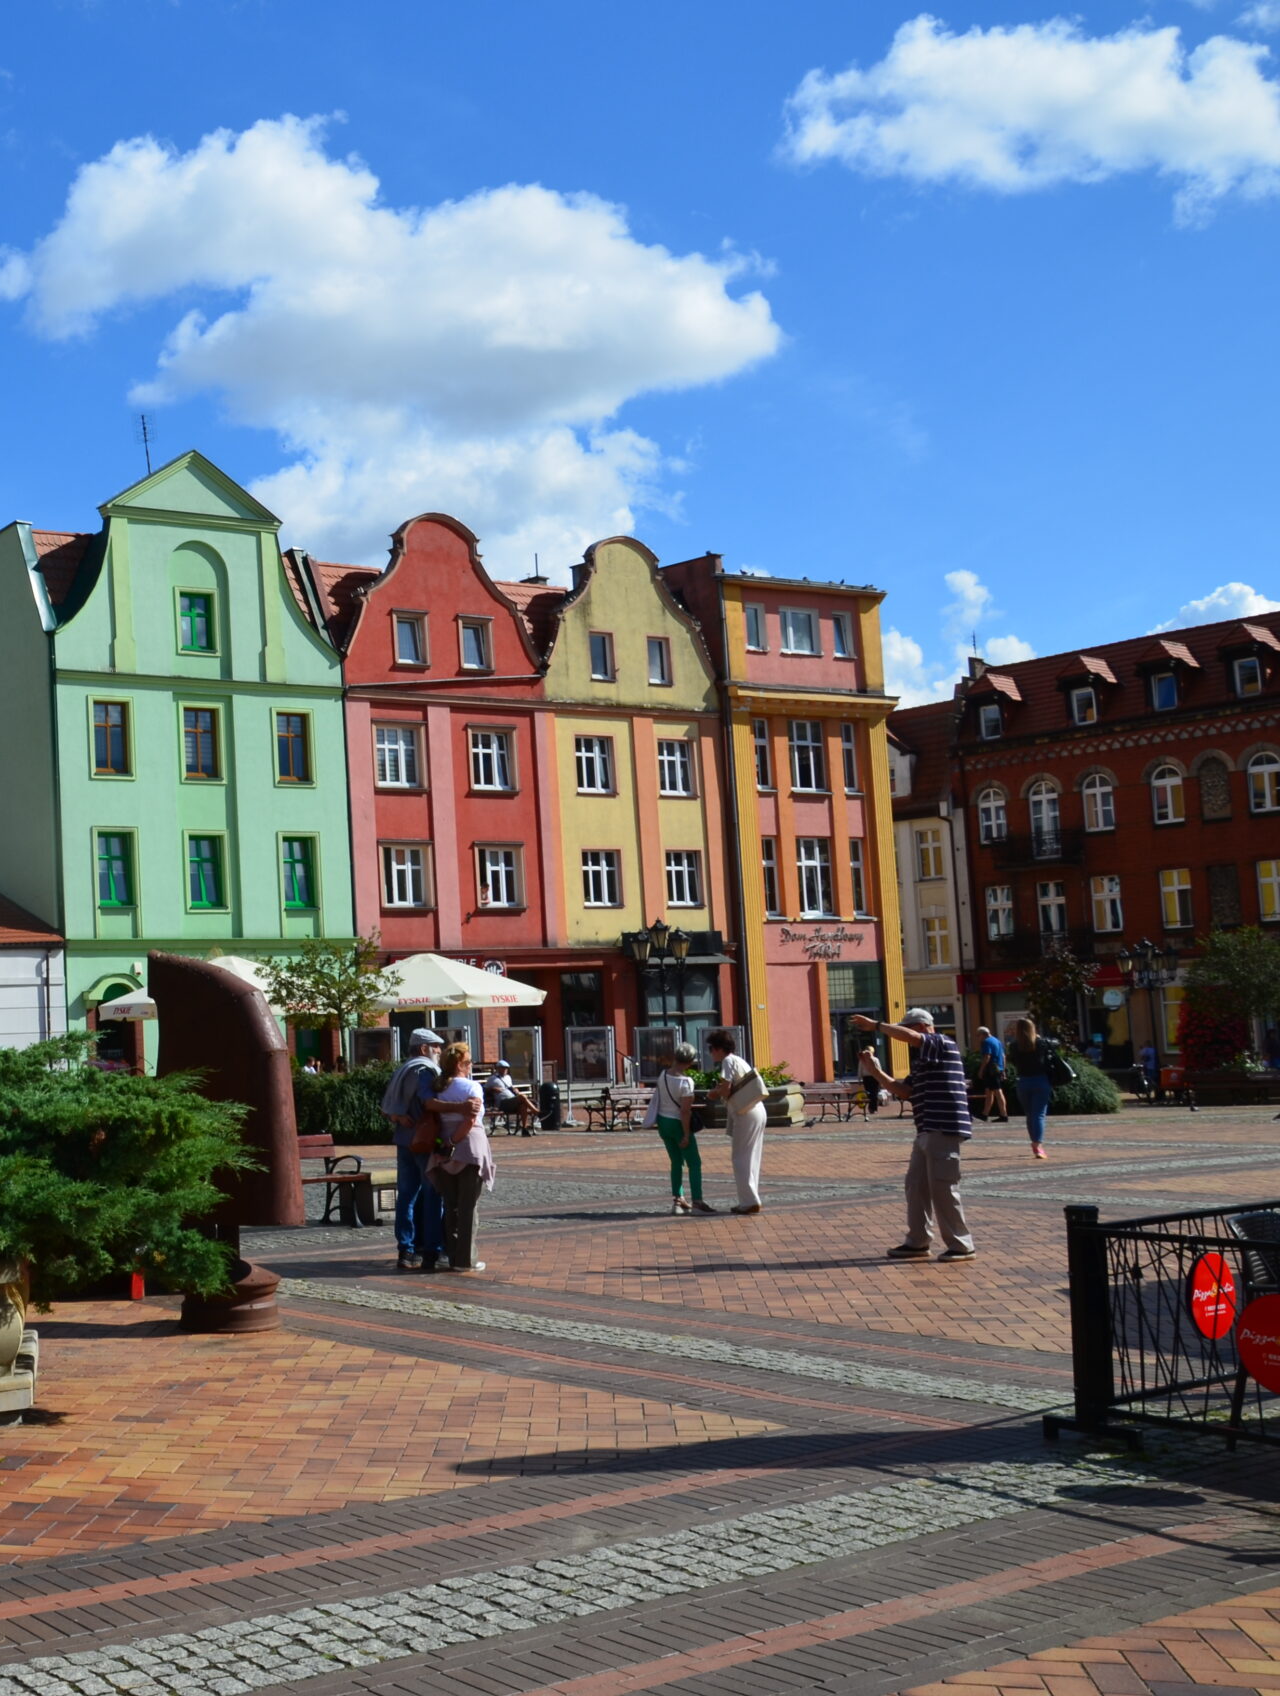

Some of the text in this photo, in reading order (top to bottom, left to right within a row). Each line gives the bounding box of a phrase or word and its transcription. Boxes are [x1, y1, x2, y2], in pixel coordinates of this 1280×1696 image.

[780, 927, 806, 945] Dom
[397, 997, 431, 1005] TYSKIE
[490, 994, 518, 1003] TYSKIE
[1239, 1327, 1277, 1345] Pizza
